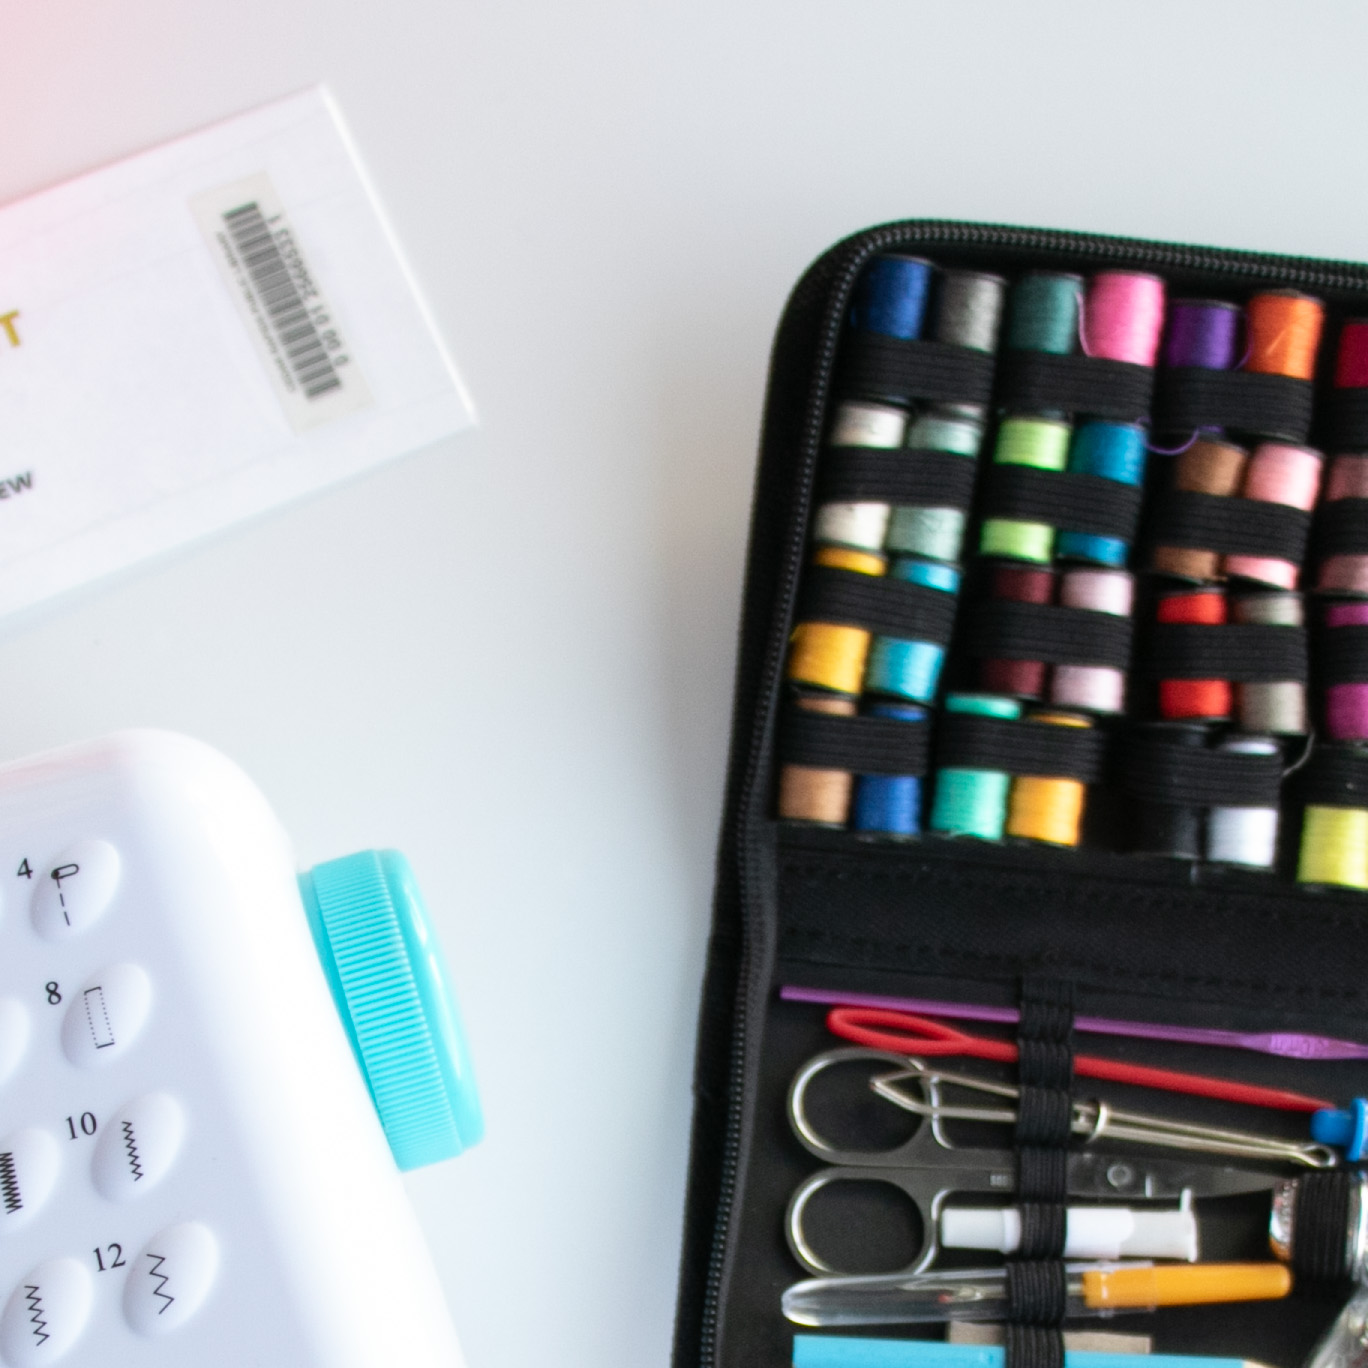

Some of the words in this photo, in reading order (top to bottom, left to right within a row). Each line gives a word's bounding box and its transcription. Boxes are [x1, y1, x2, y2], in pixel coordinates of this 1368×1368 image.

[17, 858, 33, 879] 4
[45, 981, 62, 1005] 8
[66, 1111, 97, 1140] 10
[93, 1243, 126, 1272] 12
